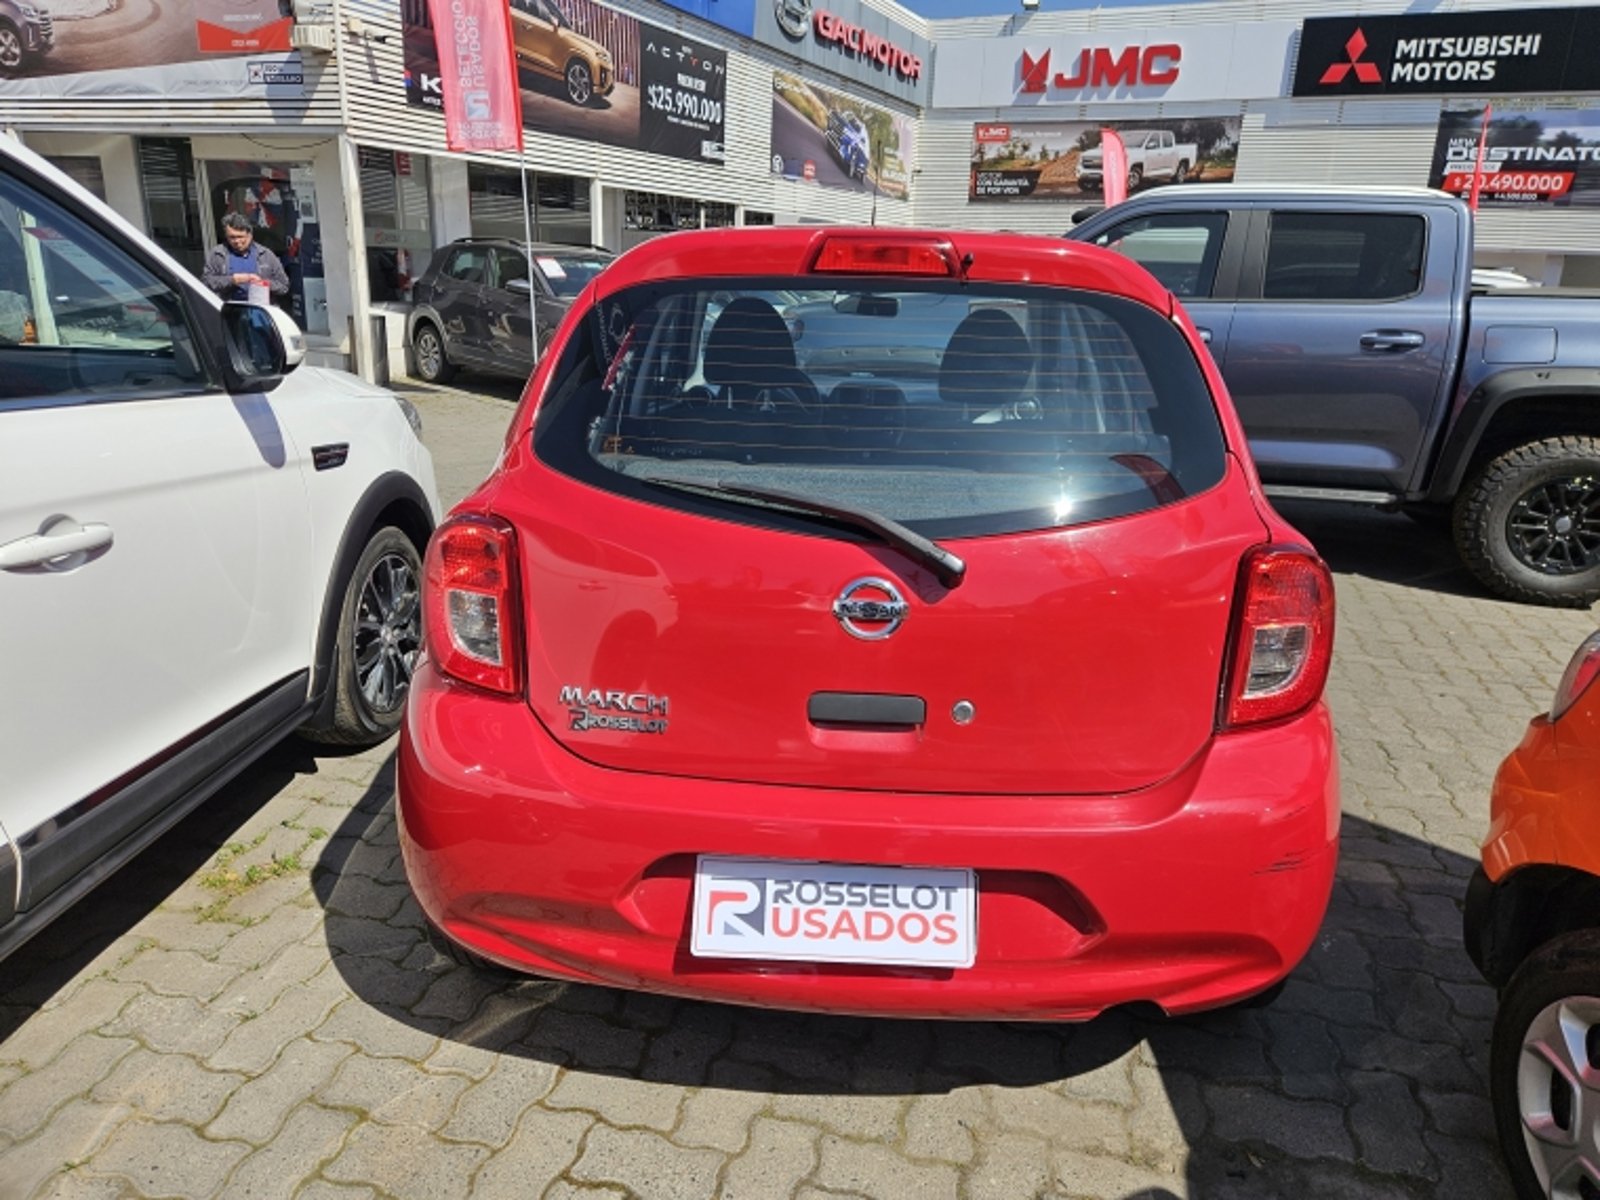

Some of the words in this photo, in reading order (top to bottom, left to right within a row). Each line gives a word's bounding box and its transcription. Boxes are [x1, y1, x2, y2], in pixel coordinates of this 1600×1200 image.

[813, 9, 861, 53] GAC
[861, 29, 922, 80] MOTOR
[1395, 34, 1541, 59] MITSUBISHI
[1054, 44, 1181, 89] JMC
[1391, 60, 1496, 82] MOTORS
[1448, 138, 1477, 147] NEW
[839, 602, 902, 617] NISSAN
[559, 685, 669, 715] MARCH
[772, 880, 958, 911] ROSSELOT
[772, 907, 958, 944] USADOS
